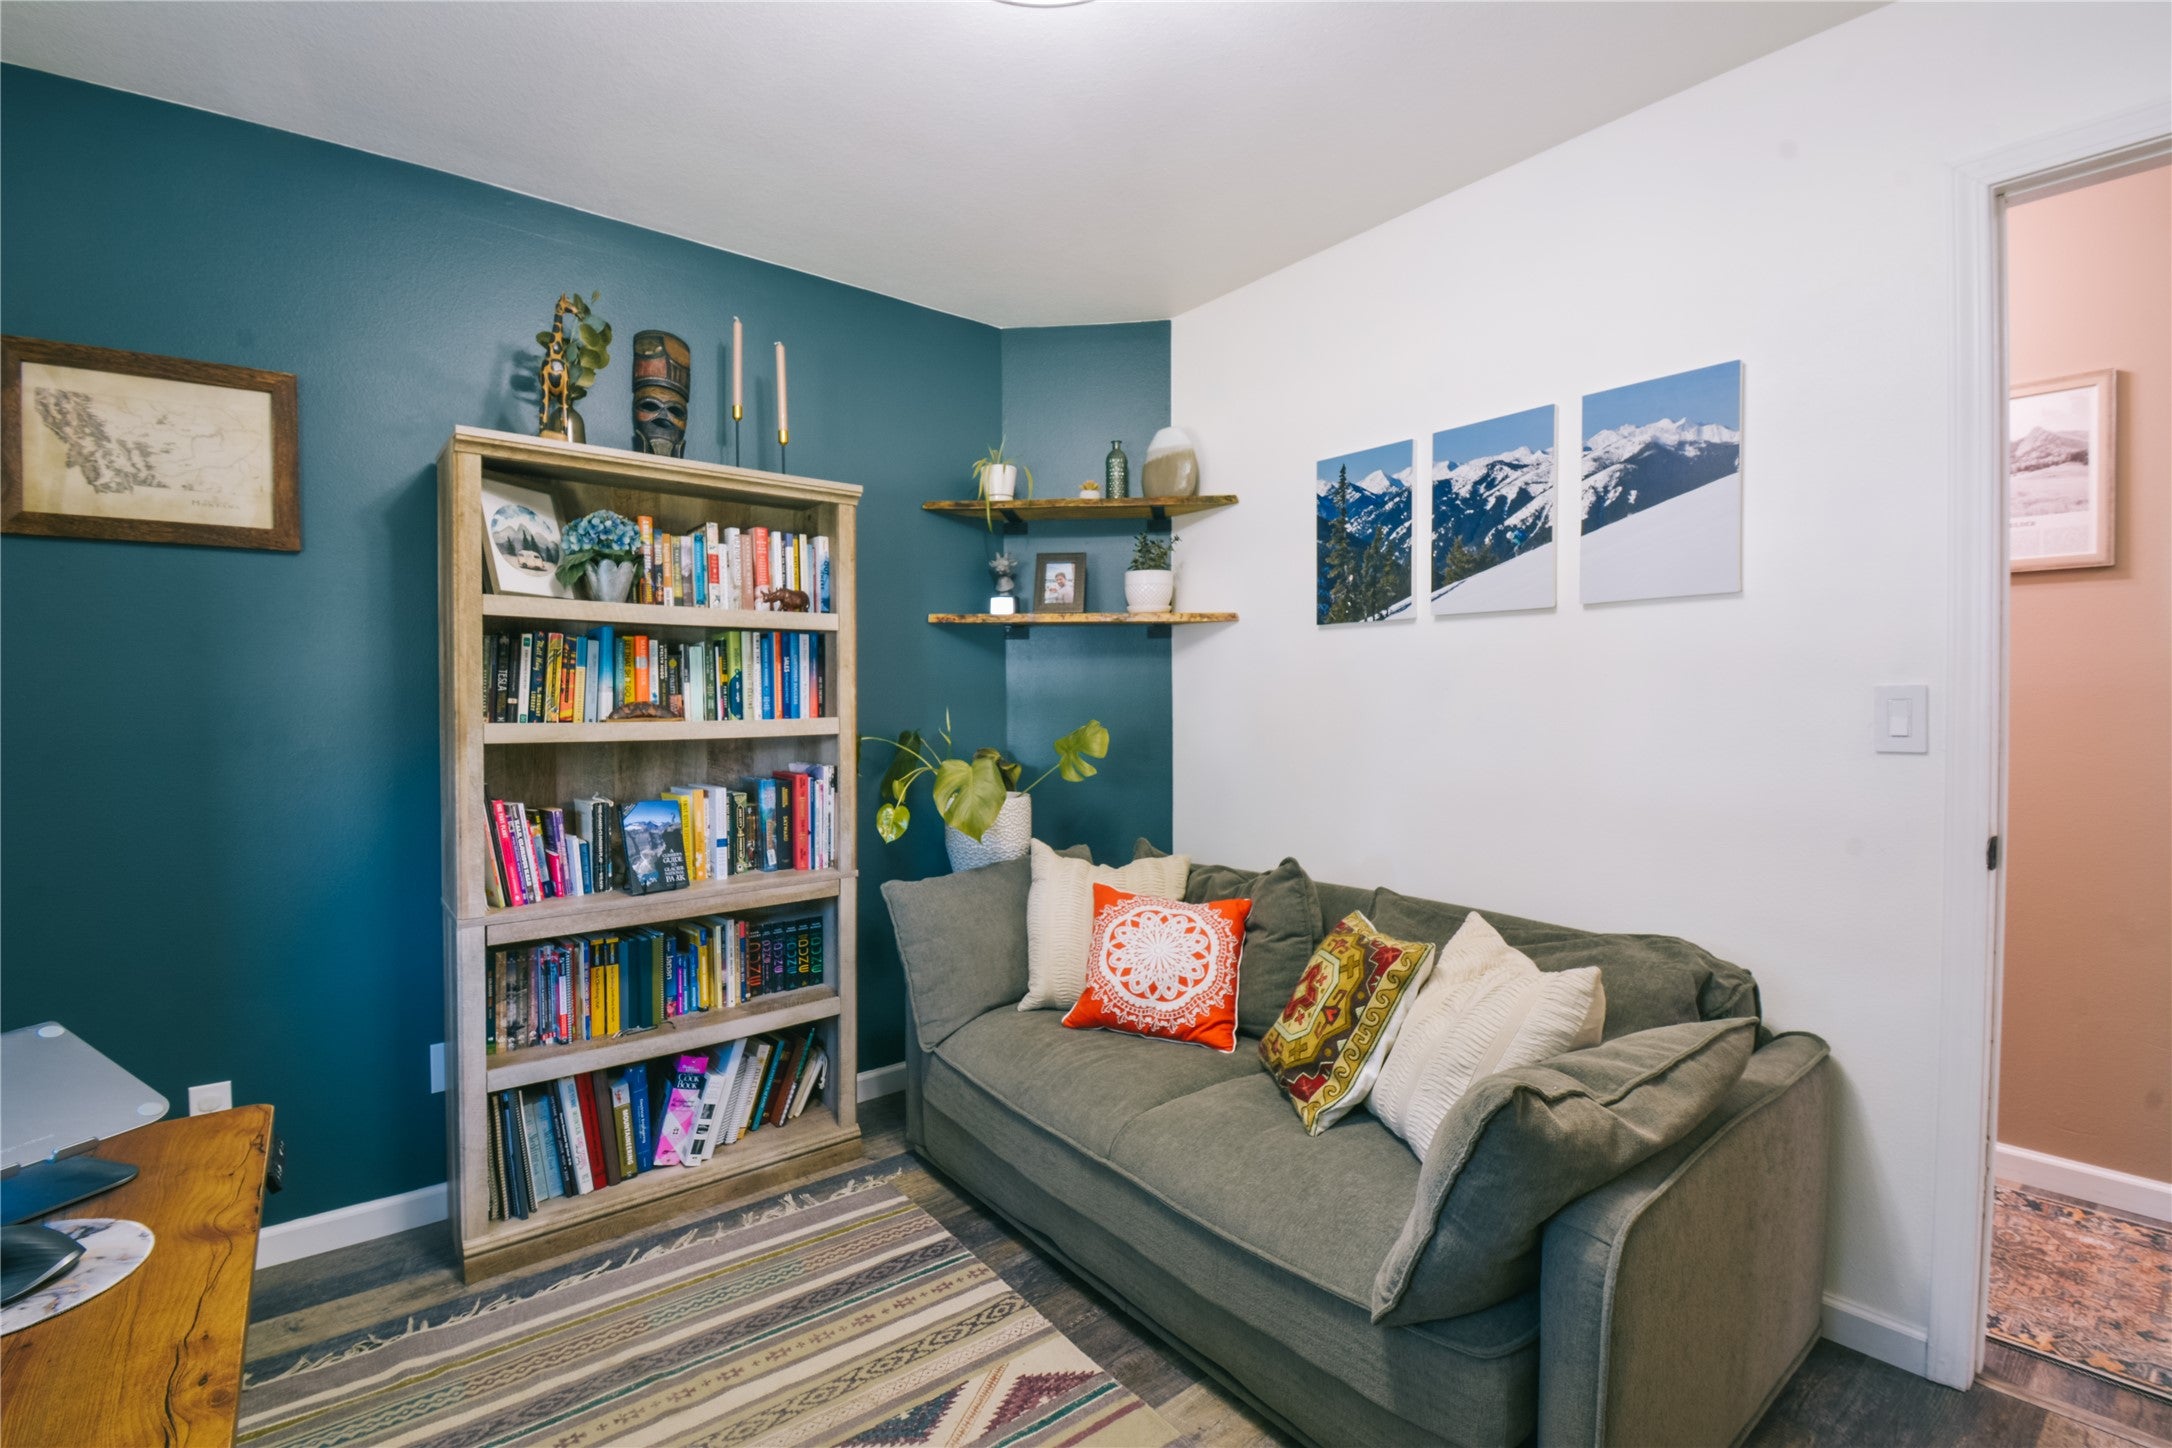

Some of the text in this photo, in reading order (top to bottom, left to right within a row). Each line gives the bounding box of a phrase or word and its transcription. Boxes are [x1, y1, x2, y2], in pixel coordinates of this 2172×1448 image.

[533, 640, 544, 671] Matt Haig
[498, 670, 508, 691] TESLA
[518, 838, 527, 869] GLORIOUS
[665, 874, 686, 882] PARK
[747, 1068, 761, 1106] nurture
[622, 1109, 633, 1165] MOUNTAINEERING
